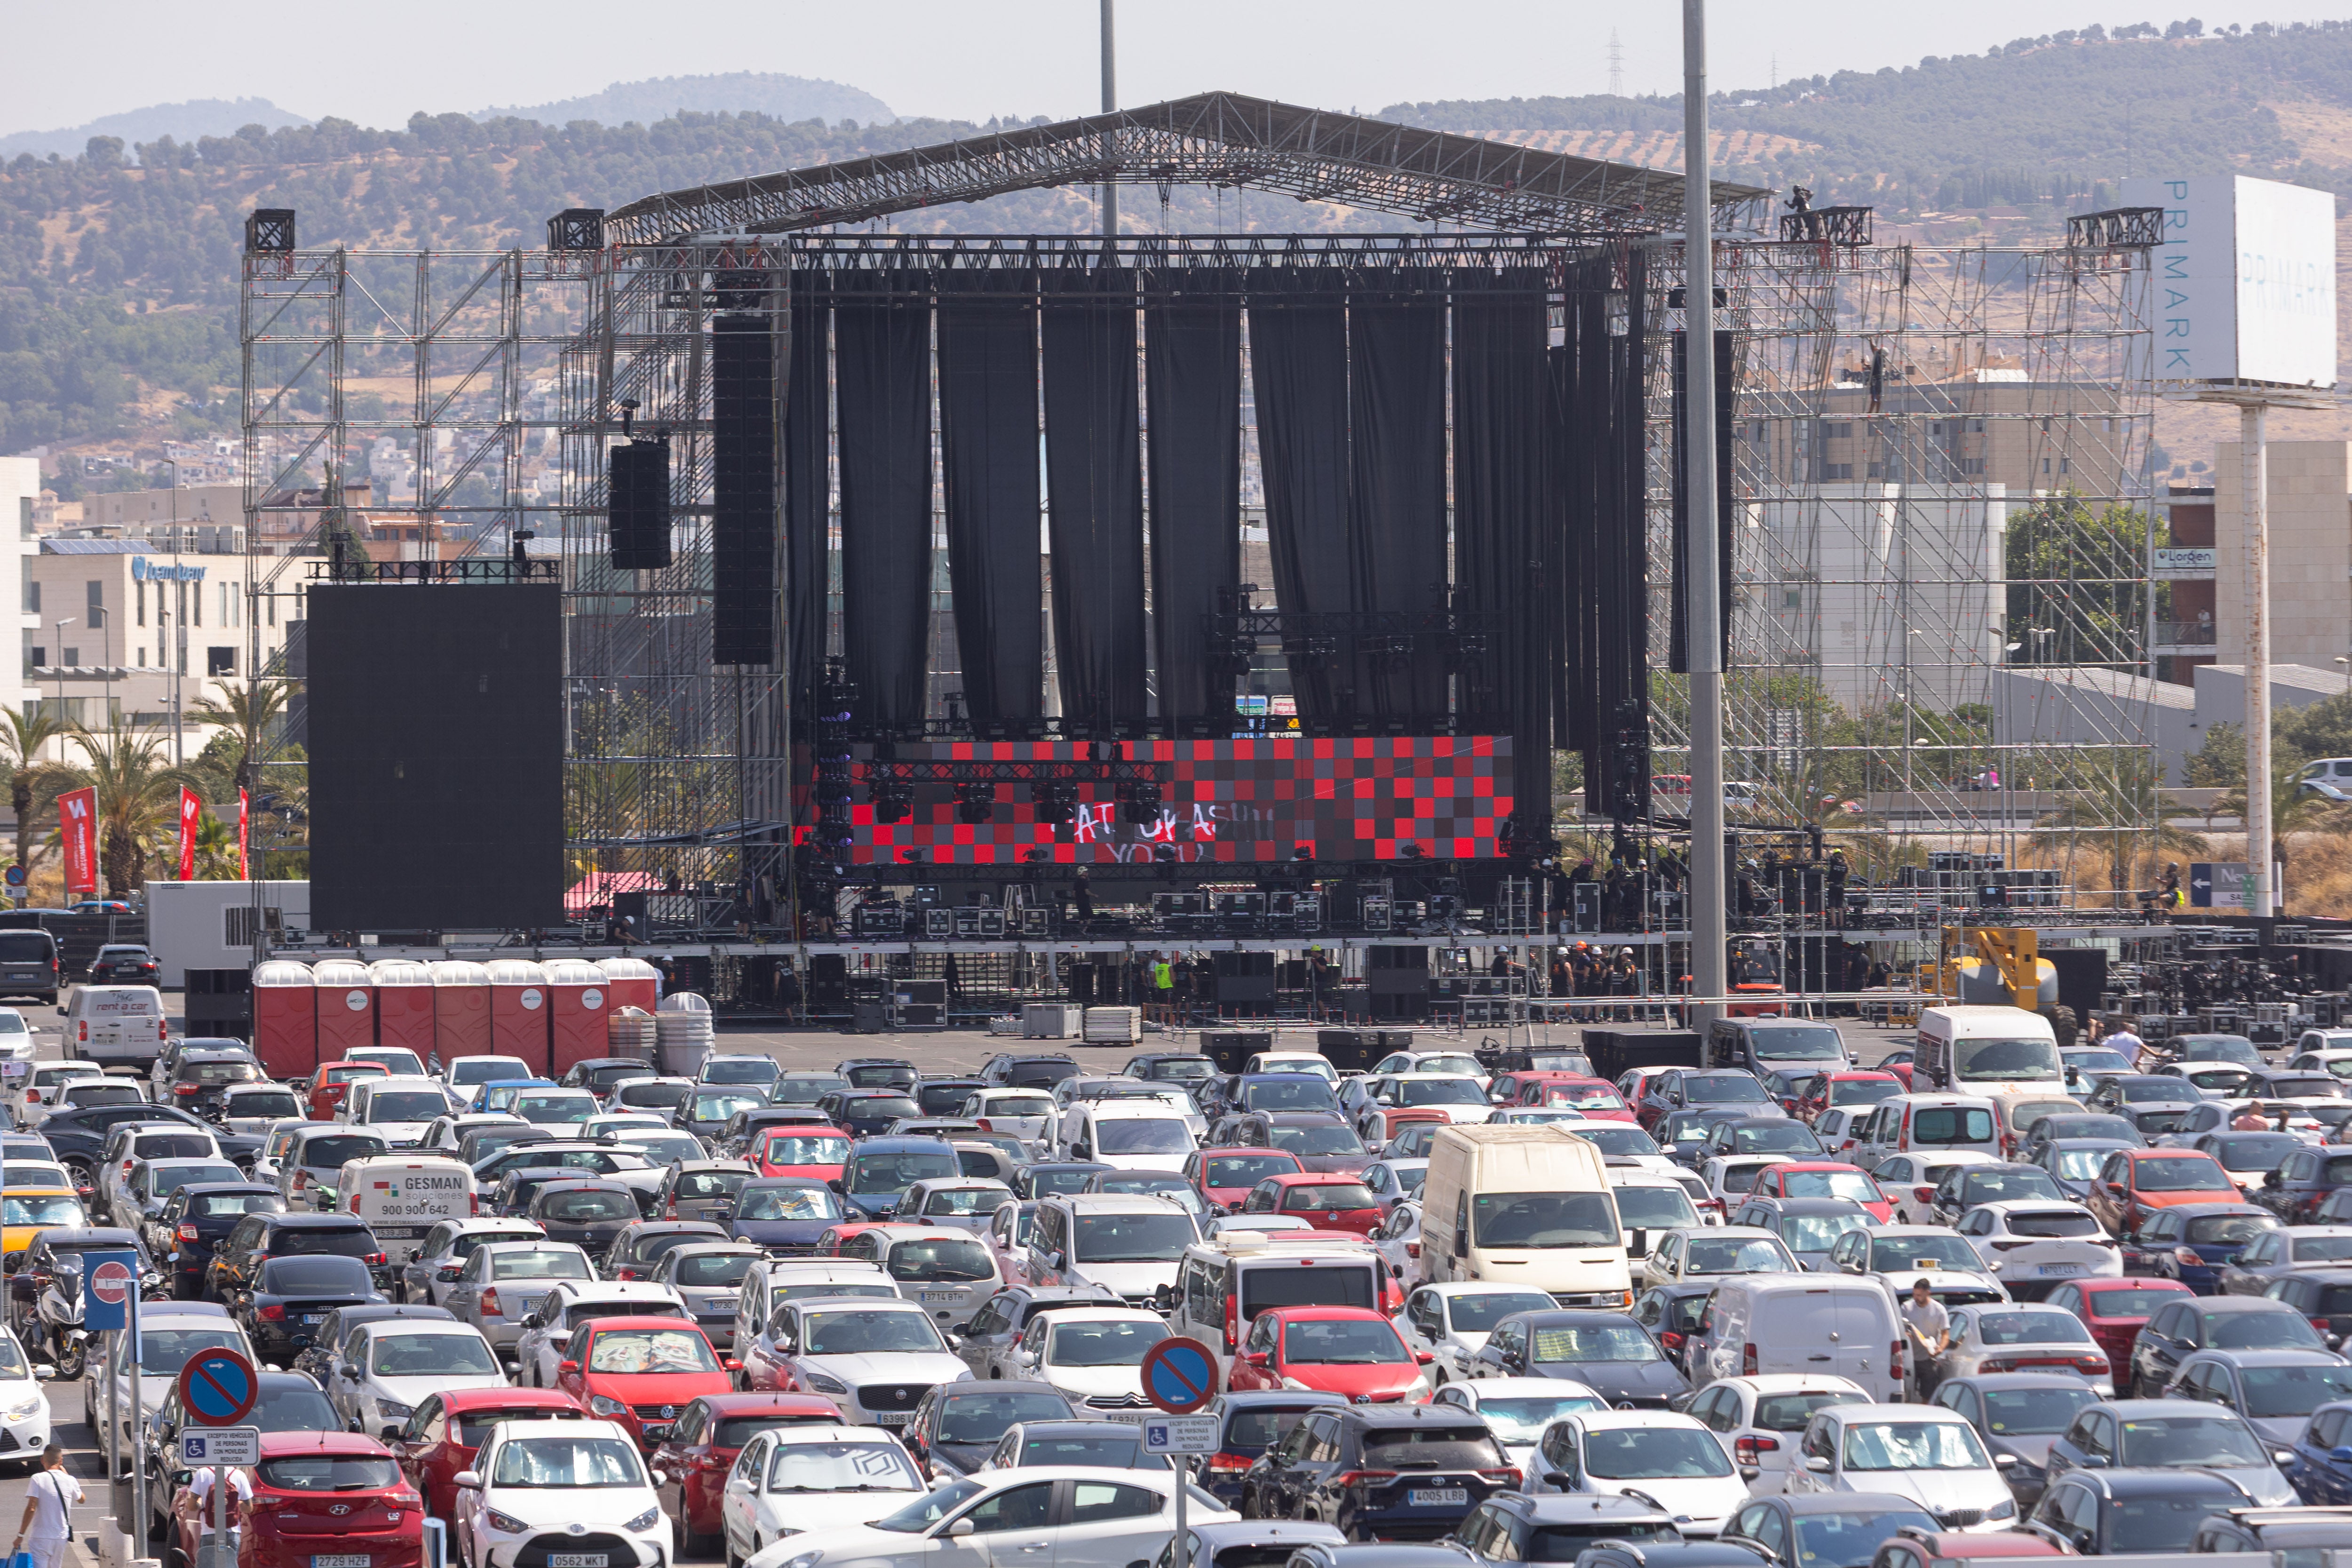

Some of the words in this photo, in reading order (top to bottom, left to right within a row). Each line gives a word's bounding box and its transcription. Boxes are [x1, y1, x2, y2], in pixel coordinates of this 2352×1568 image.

[2164, 181, 2190, 369] PRIMARK
[2243, 252, 2331, 317] PRIMARK
[405, 1178, 462, 1189] GESMAN
[406, 1191, 463, 1200] soluciones
[382, 1206, 402, 1215] 900
[405, 1206, 425, 1215] 900
[429, 1205, 449, 1214] 642
[1416, 1490, 1442, 1501] 4005
[1446, 1489, 1465, 1500] LBB
[318, 1556, 345, 1566] 2729
[348, 1556, 367, 1566] HZF
[556, 1556, 581, 1566] 0562
[586, 1556, 604, 1566] MKT
